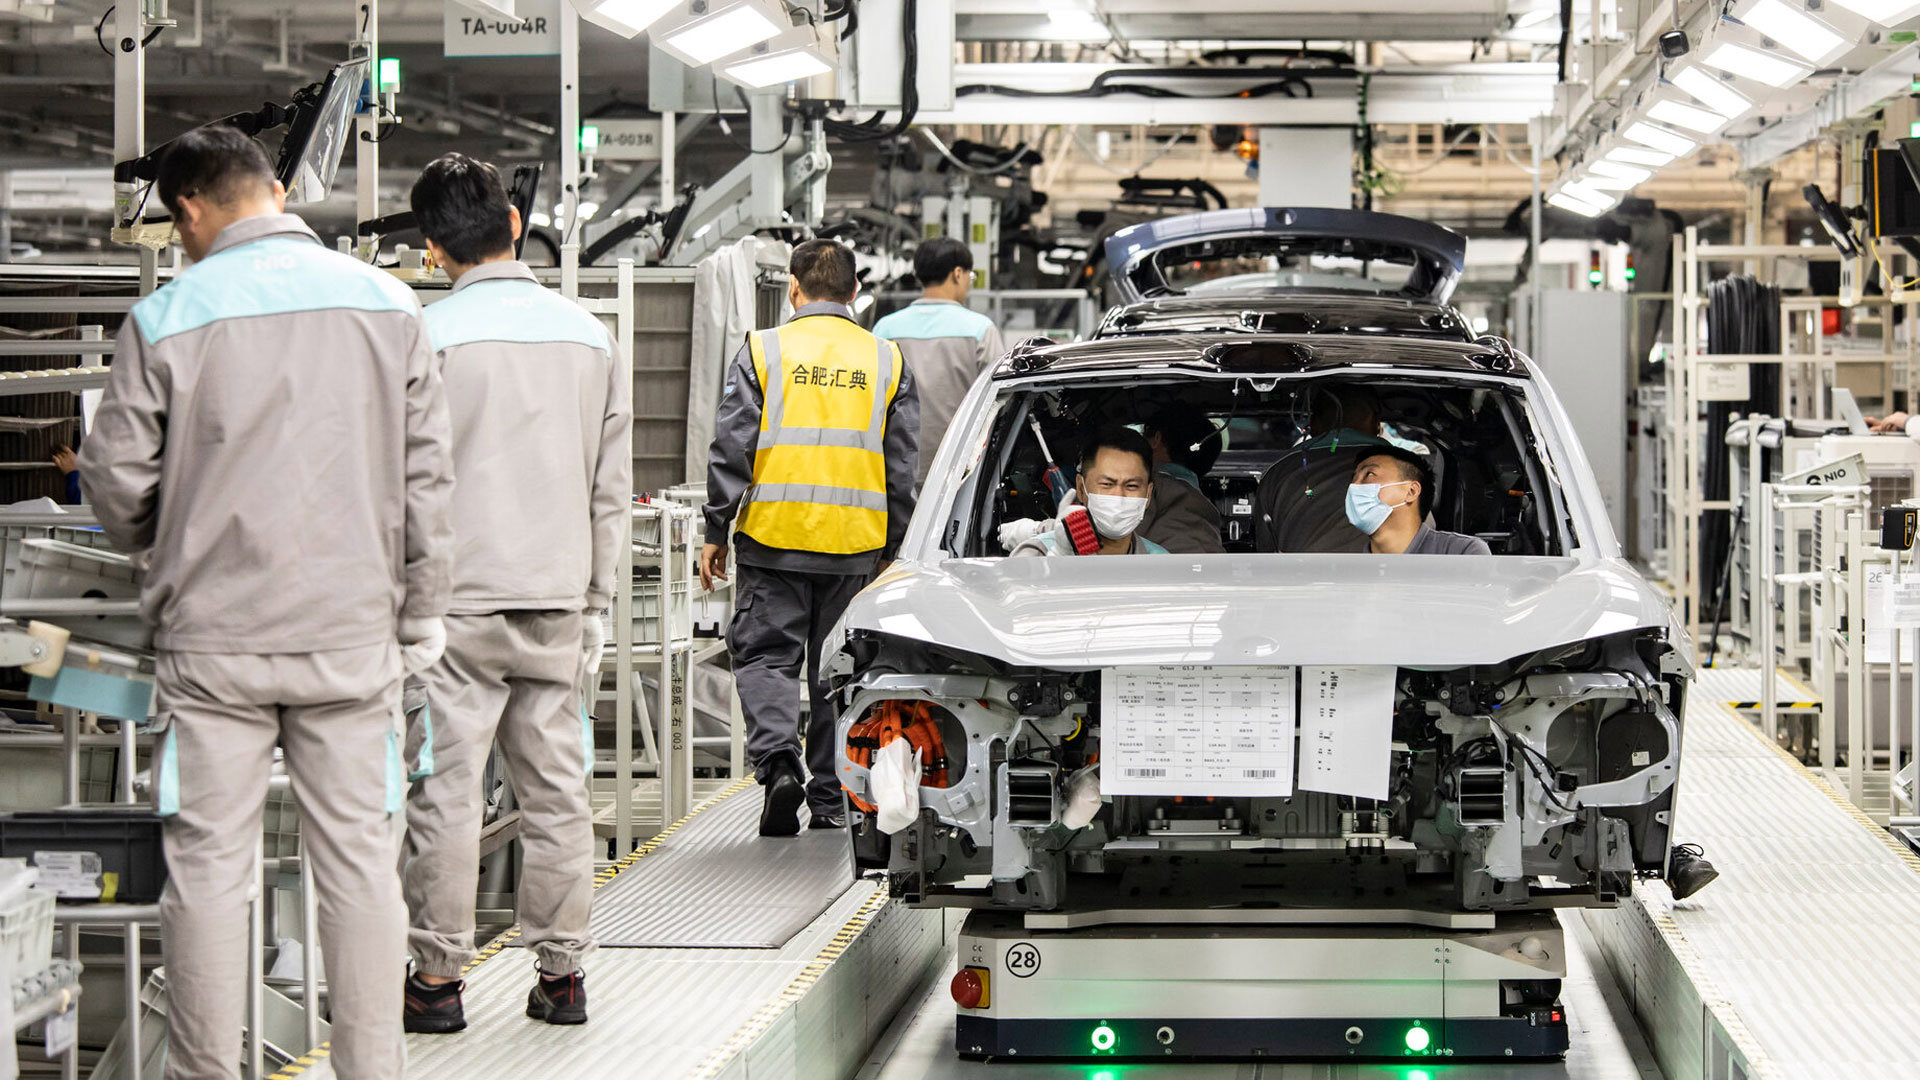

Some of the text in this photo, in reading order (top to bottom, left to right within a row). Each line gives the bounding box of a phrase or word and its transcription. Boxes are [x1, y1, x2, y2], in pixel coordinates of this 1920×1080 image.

[461, 17, 547, 35] TA-004R
[253, 254, 297, 272] NIO
[792, 363, 868, 391] 合肥汇典
[1823, 468, 1847, 483] NIO
[672, 732, 683, 751] 003
[1011, 950, 1036, 968] 28
